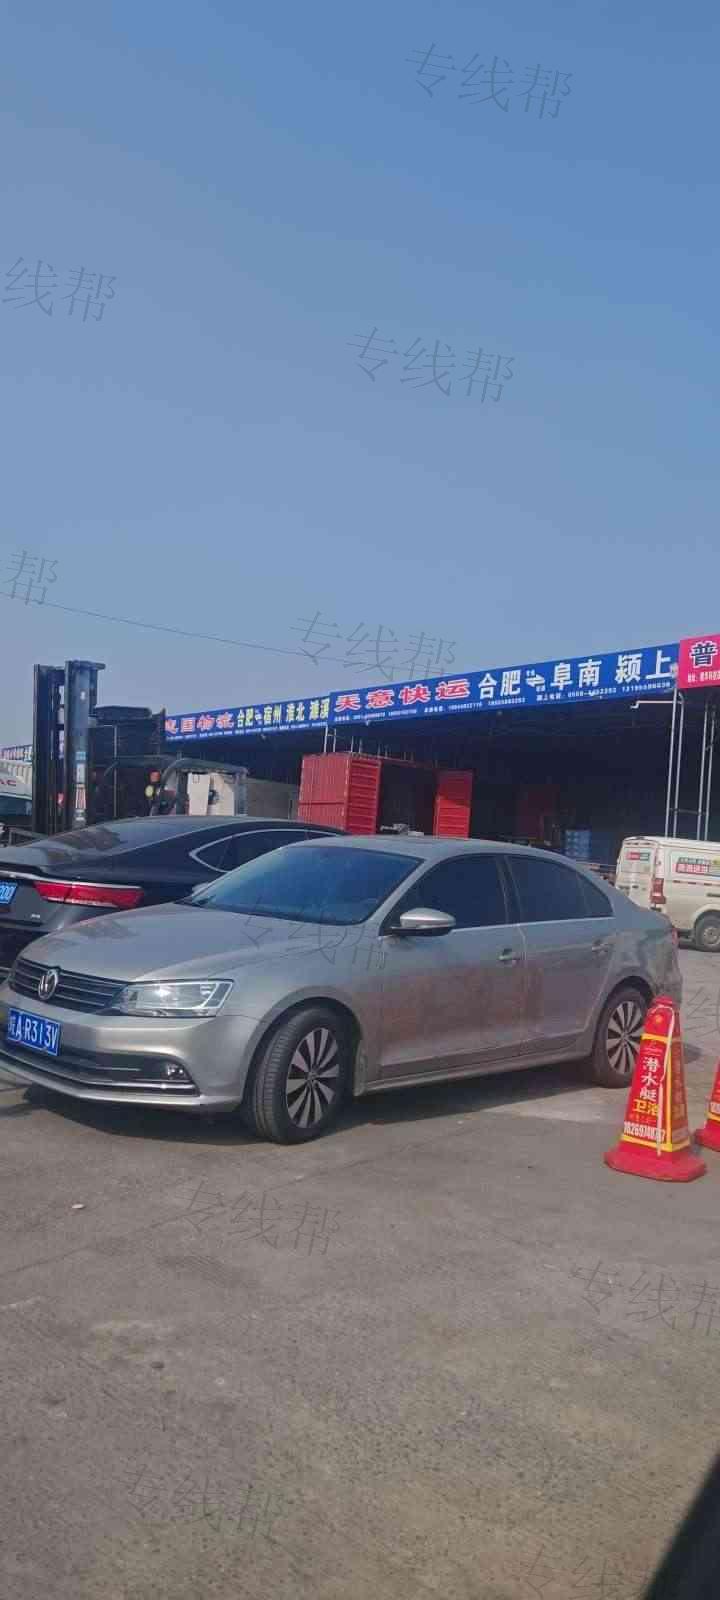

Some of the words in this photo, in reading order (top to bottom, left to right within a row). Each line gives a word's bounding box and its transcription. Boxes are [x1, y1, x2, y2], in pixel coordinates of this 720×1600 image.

[689, 640, 718, 668] 普
[334, 678, 471, 713] 天意快运
[478, 669, 521, 699] 合肥
[550, 658, 602, 690] 阜南
[237, 708, 254, 728] 合肥
[263, 704, 282, 725] 宿州
